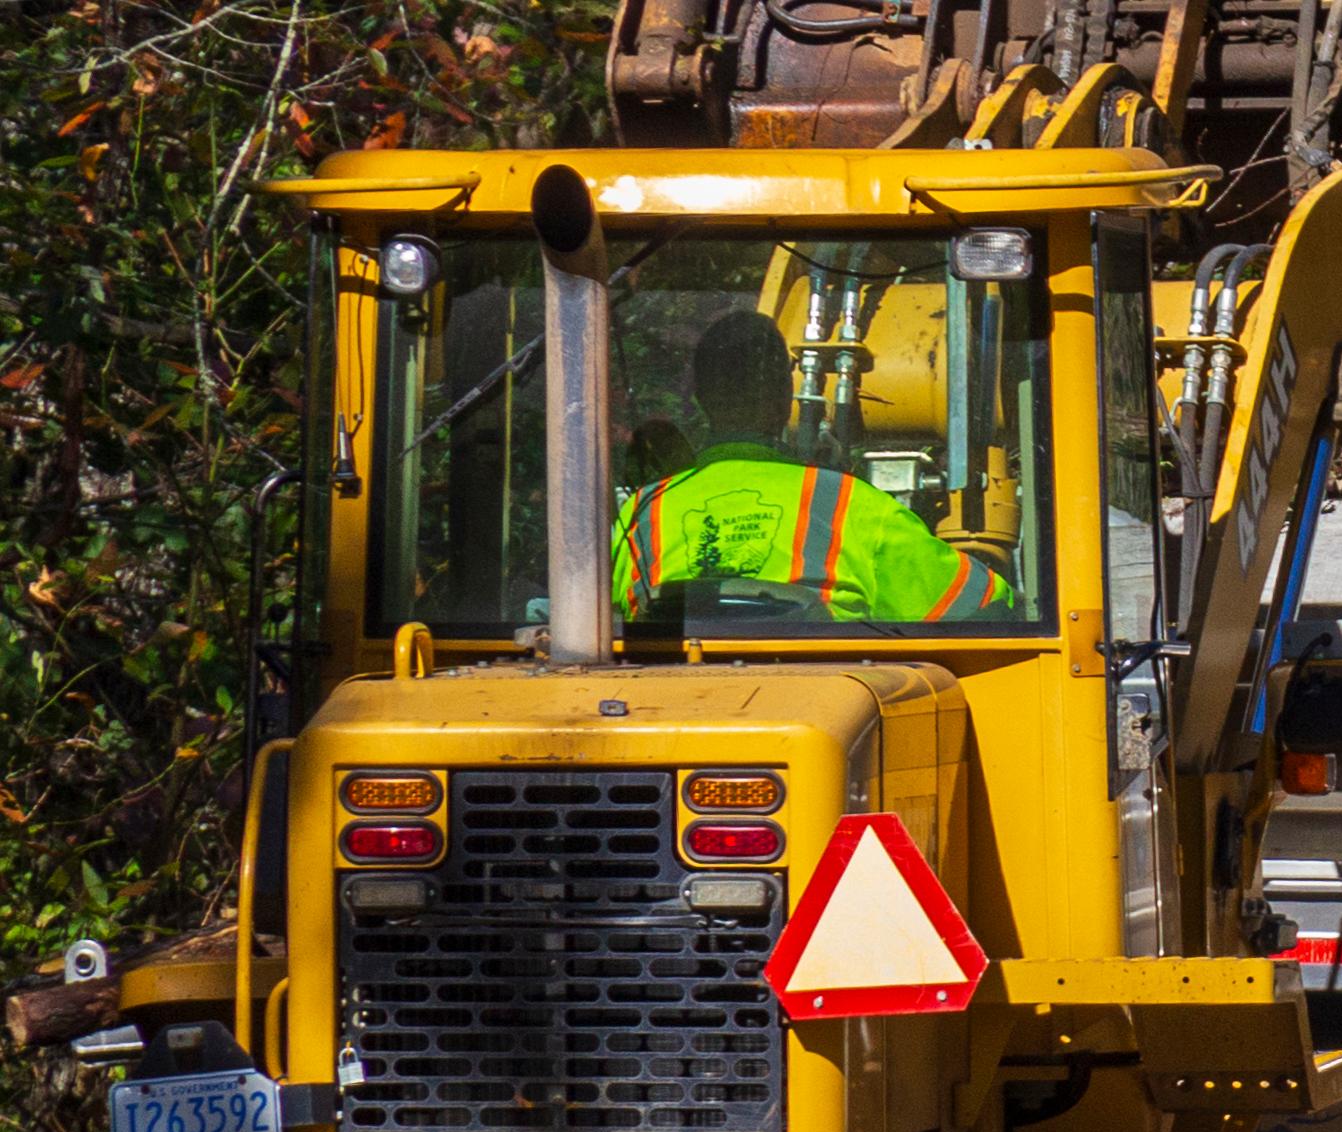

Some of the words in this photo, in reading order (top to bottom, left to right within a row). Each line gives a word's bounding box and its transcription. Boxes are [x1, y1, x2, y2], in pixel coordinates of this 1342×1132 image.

[1237, 325, 1297, 572] 444H
[722, 512, 775, 526] NATIONAL
[733, 522, 761, 532] PARK
[725, 531, 768, 542] SERVICE
[171, 1082, 239, 1096] GOVERNMENT
